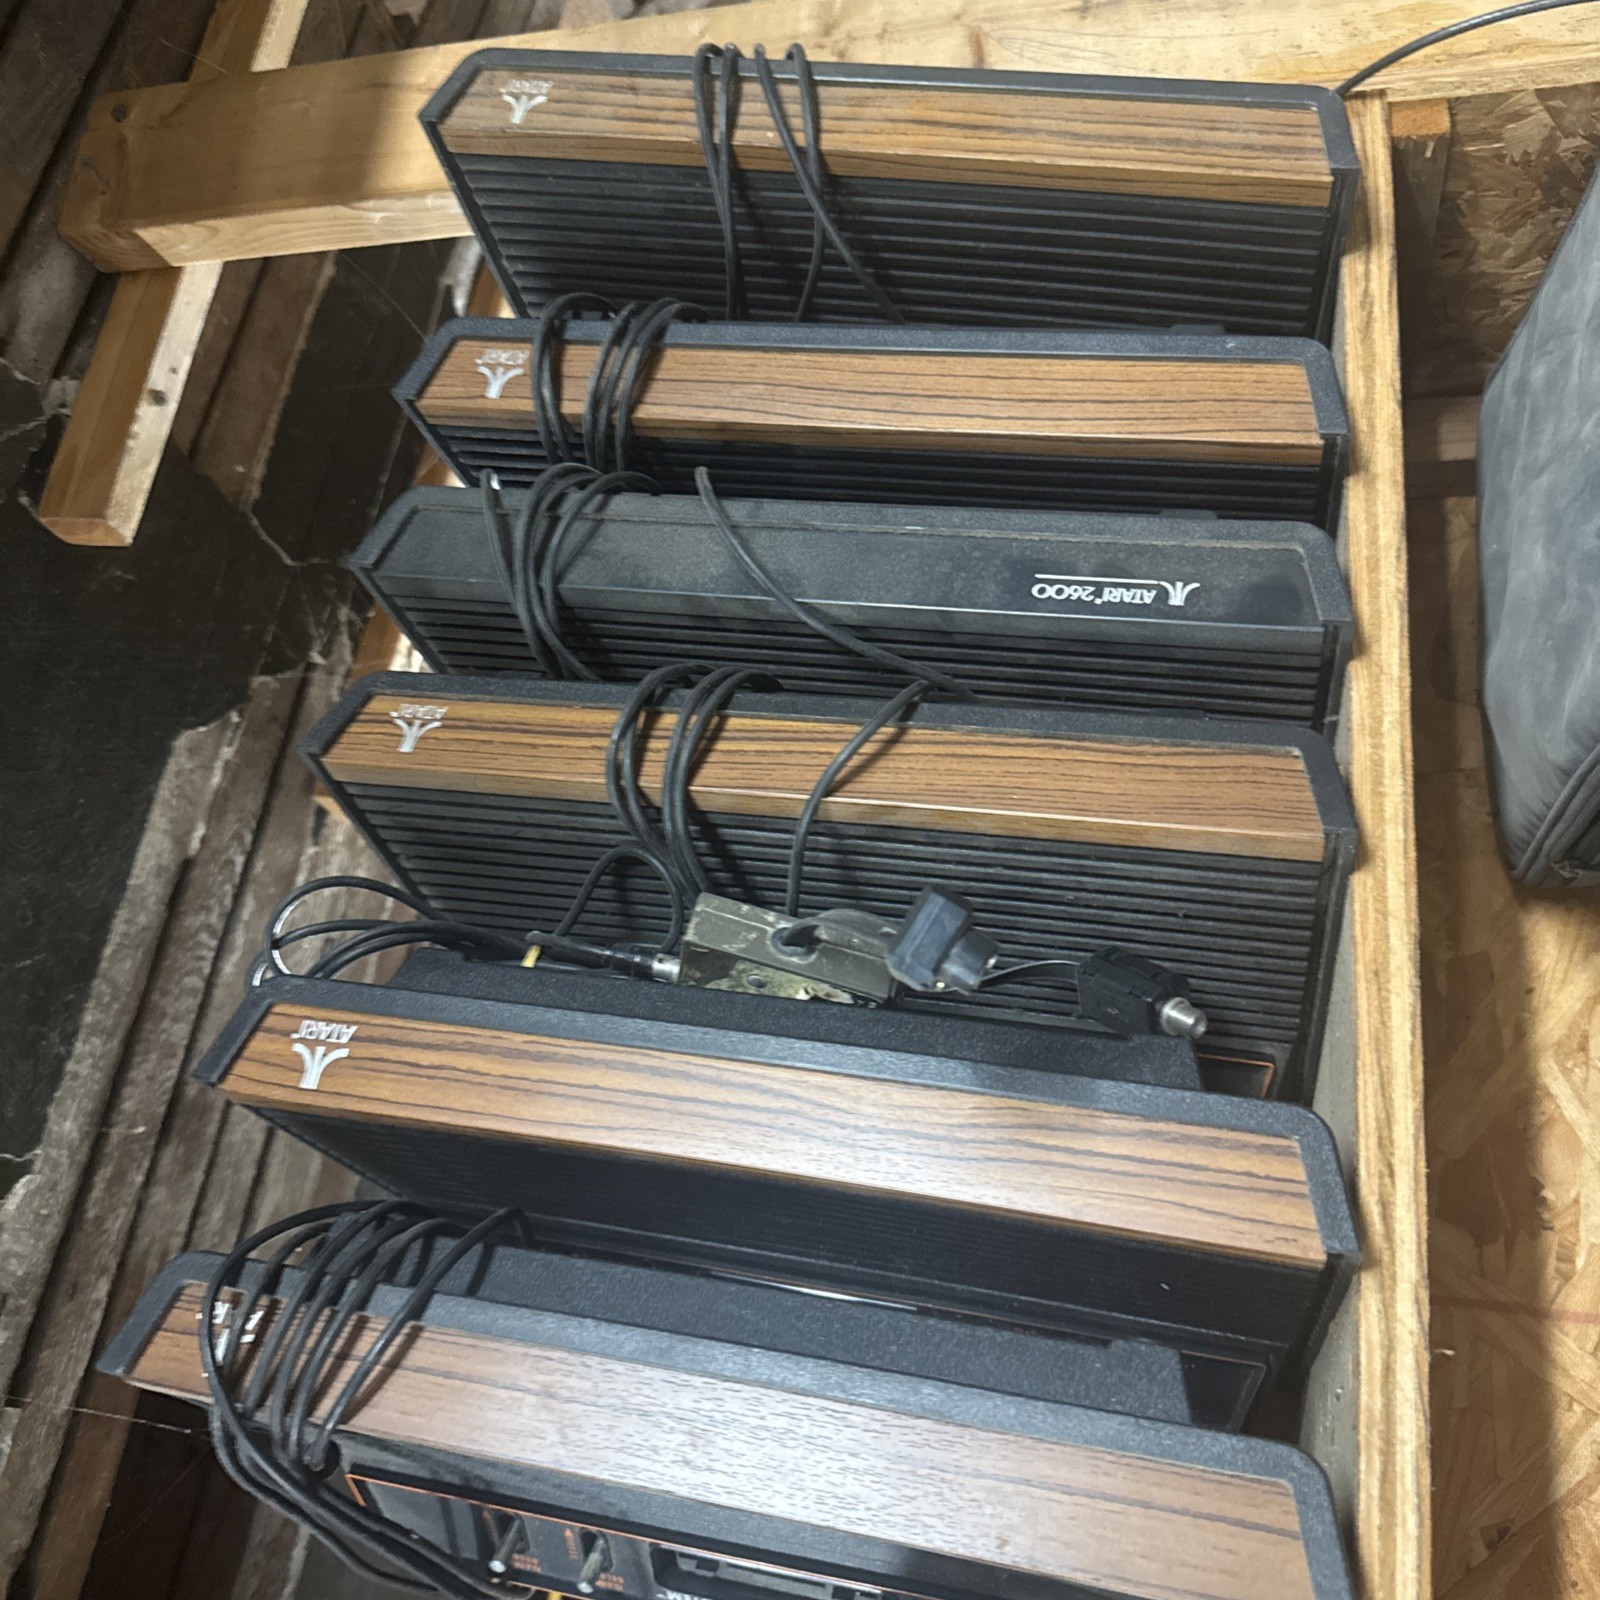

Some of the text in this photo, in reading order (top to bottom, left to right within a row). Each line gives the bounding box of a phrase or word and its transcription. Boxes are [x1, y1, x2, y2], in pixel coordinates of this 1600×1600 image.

[1031, 583, 1157, 604] ATARI 2600
[298, 1019, 359, 1044] ATARI
